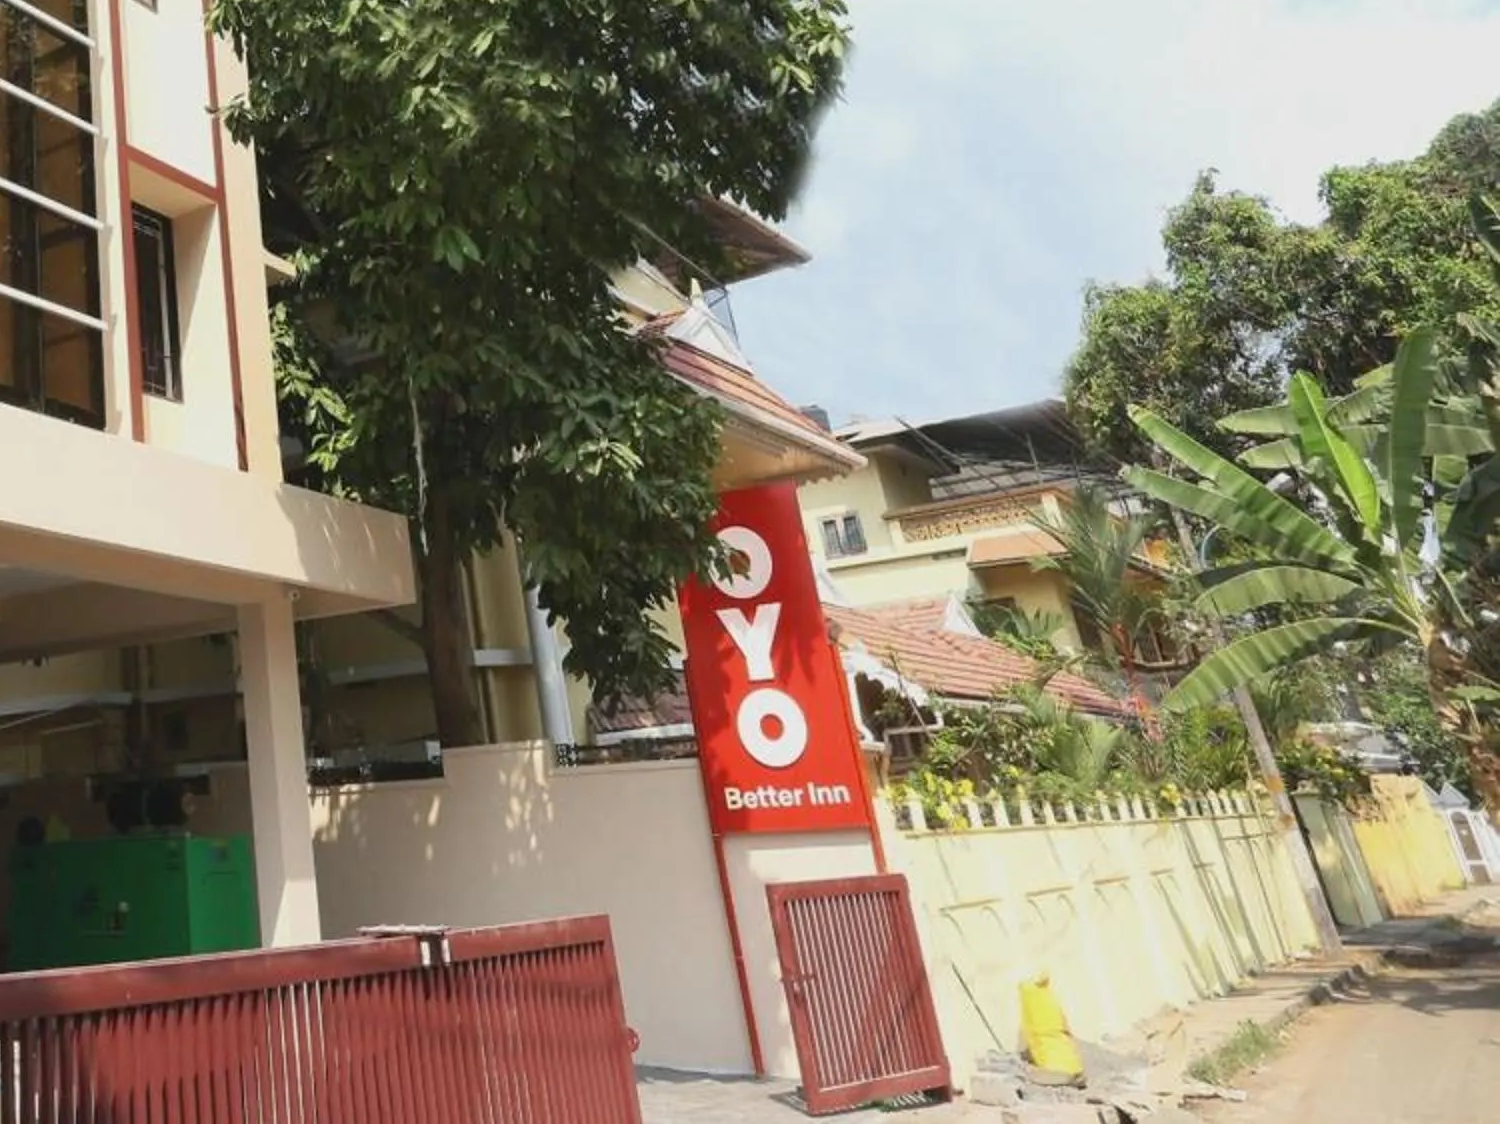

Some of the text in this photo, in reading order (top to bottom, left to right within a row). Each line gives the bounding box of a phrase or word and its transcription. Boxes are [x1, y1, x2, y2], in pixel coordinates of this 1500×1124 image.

[709, 525, 808, 768] OYO
[724, 782, 851, 810] Better Inn
